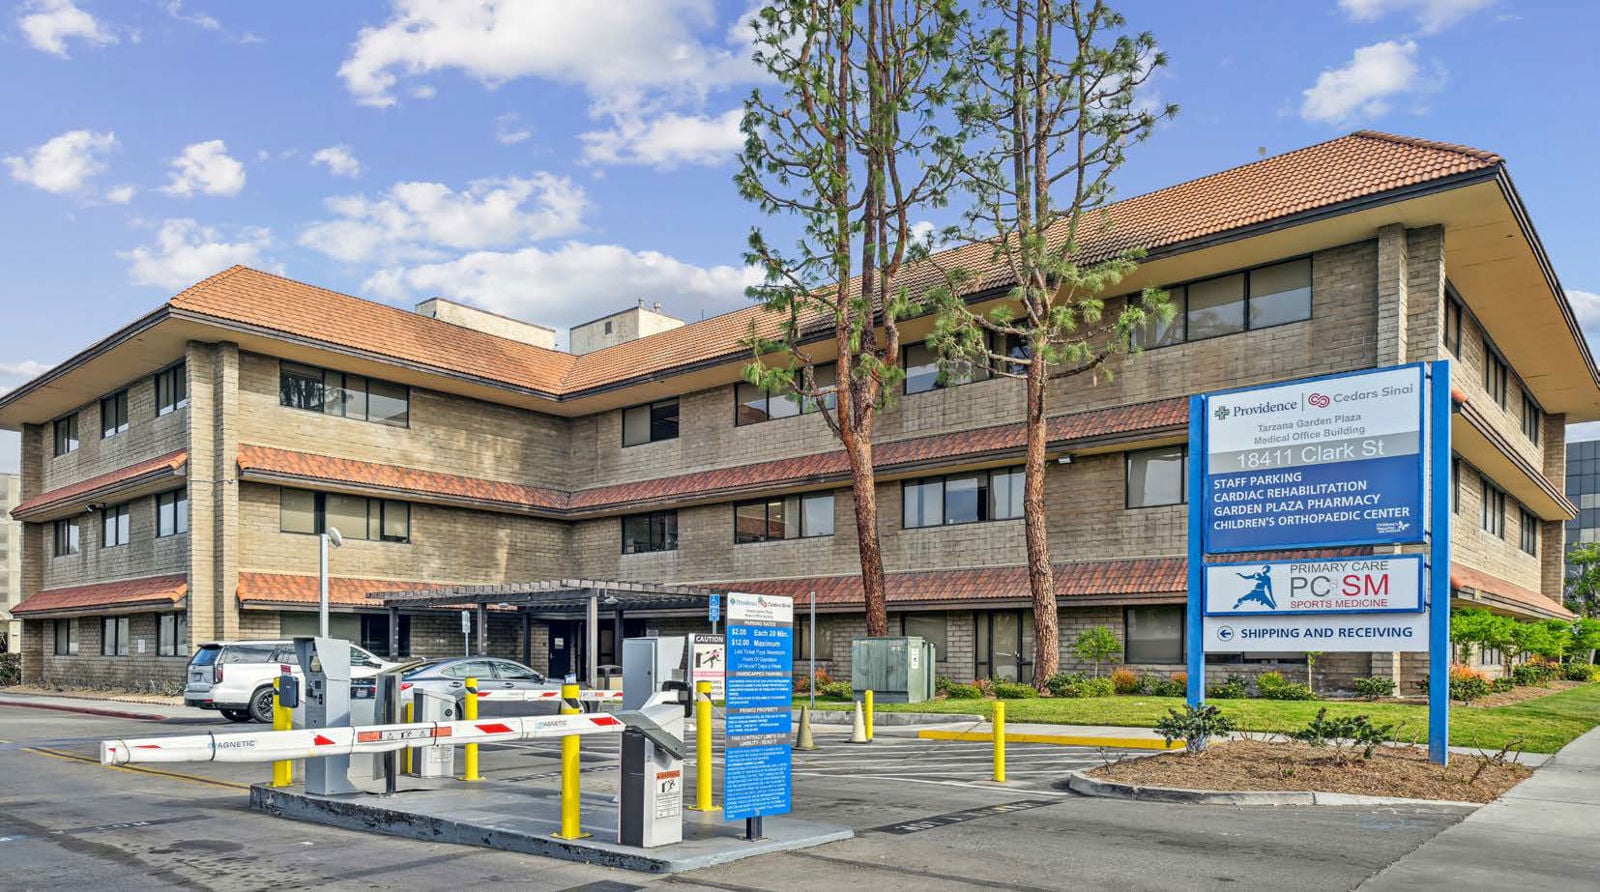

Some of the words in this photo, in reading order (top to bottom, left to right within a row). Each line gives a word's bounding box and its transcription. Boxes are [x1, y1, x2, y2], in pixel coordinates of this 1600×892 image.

[1233, 400, 1297, 417] Providence
[1333, 388, 1378, 403] Cedars
[1381, 383, 1414, 398] Sinai
[1258, 422, 1294, 433] Tarzana
[1296, 417, 1332, 429] Garden
[1334, 413, 1362, 424] Plaza
[1254, 433, 1290, 445] Medical
[1292, 429, 1321, 442] Office
[1323, 425, 1366, 440] Building
[1237, 449, 1292, 469] 18411
[1301, 441, 1355, 463] Clark
[1362, 440, 1385, 457] St
[1214, 477, 1247, 490] STAFF
[1250, 472, 1302, 487] PARKING
[1214, 490, 1264, 503] CARDIAC
[1267, 480, 1367, 499] REHABILITATION
[1214, 503, 1262, 517] GARDEN
[1266, 501, 1304, 513] PLAZA
[1307, 494, 1381, 510] PHARMACY
[1214, 517, 1275, 531] CHILDREN'S
[1278, 509, 1361, 526] ORTHOPAEDIC
[1363, 507, 1410, 519] CENTER
[1290, 562, 1348, 574] PRIMARY
[1351, 560, 1389, 572] CARE
[1290, 599, 1332, 609] SPORTS
[1335, 598, 1389, 608] MEDICINE
[1241, 628, 1300, 639] SHIPPING
[1303, 627, 1334, 638] AND
[1338, 626, 1413, 639] RECEIVING
[754, 639, 781, 648] Maximum
